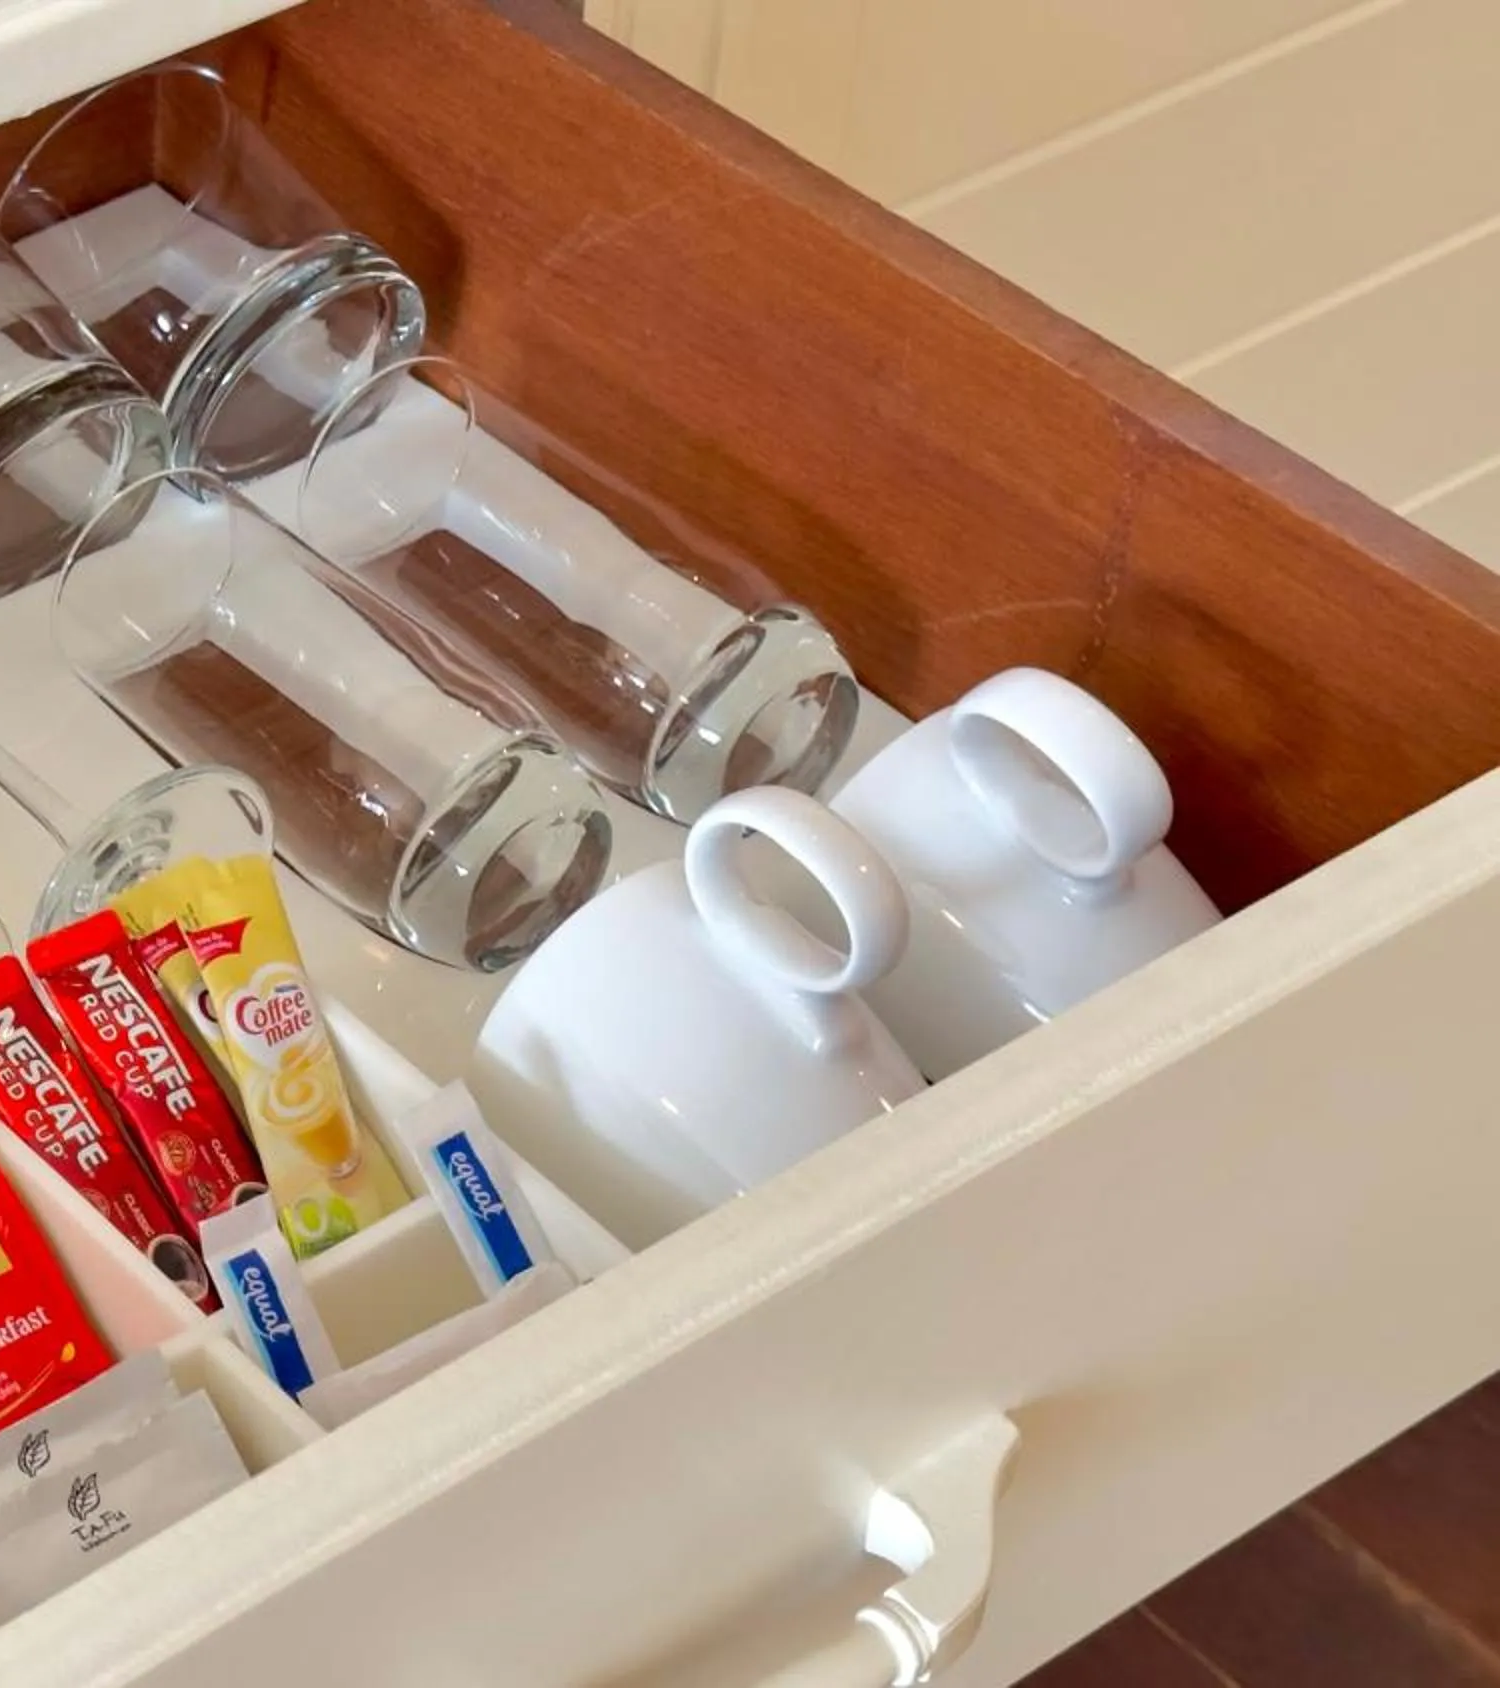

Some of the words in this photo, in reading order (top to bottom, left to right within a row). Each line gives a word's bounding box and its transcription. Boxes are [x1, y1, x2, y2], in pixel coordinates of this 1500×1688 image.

[234, 990, 305, 1035] Coffee
[263, 1008, 312, 1047] mate
[79, 993, 118, 1042] RED
[115, 1051, 154, 1099] CUP
[25, 1108, 65, 1158] CUP
[450, 1150, 504, 1222] equal
[243, 1266, 293, 1342] equal
